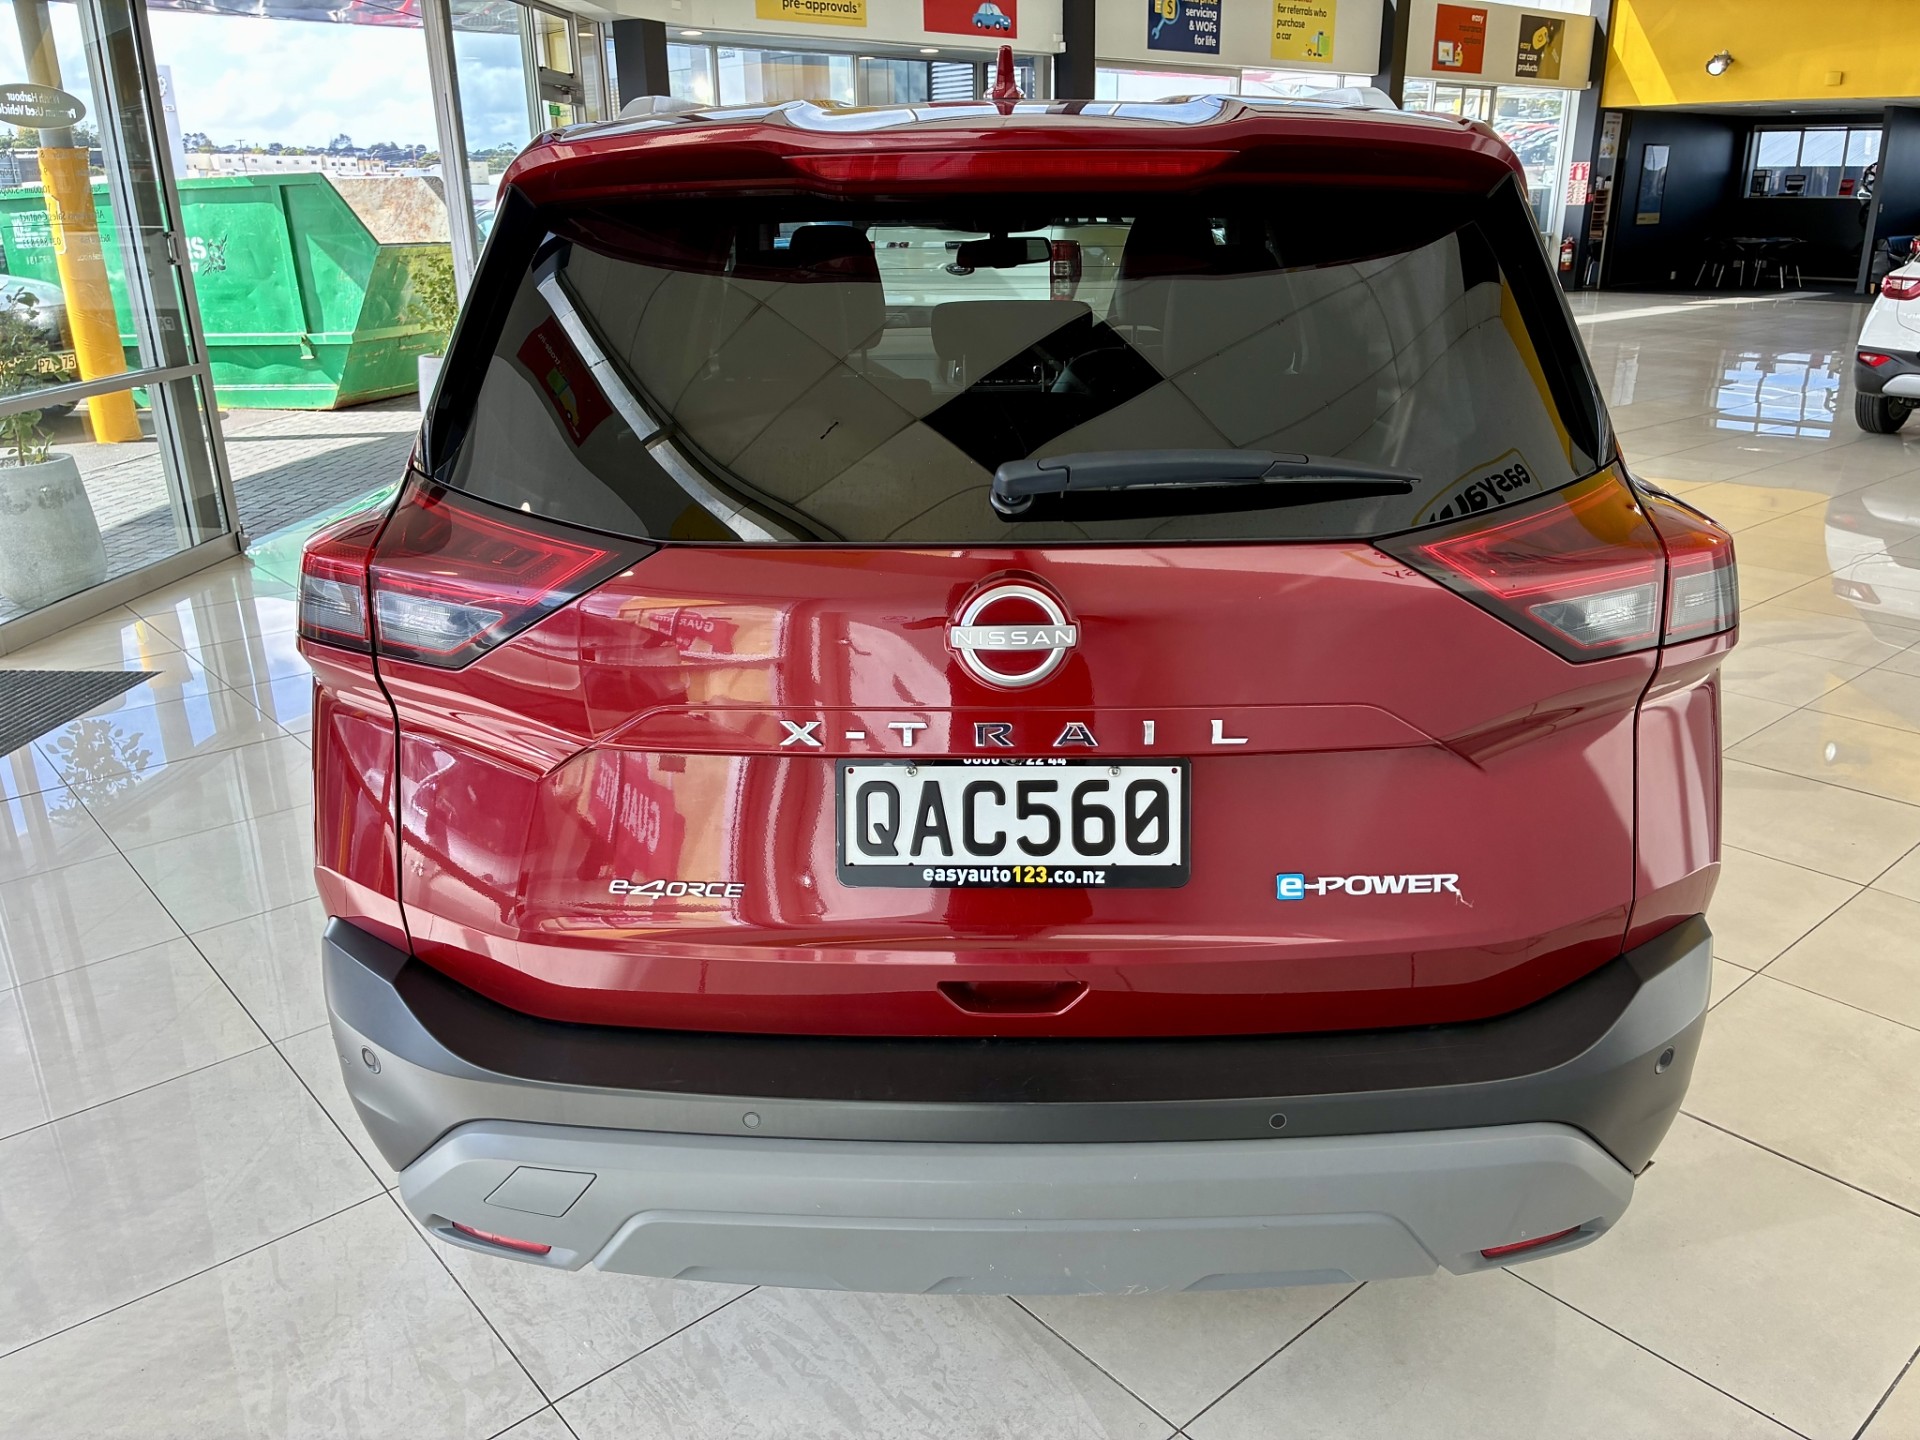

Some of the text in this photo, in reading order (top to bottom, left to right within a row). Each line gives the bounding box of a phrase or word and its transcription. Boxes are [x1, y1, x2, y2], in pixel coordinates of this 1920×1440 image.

[1185, 7, 1217, 21] servicing
[1278, 3, 1327, 17] for referrals who
[1189, 20, 1217, 33] & WOFs
[1277, 18, 1305, 28] purchase
[1194, 34, 1216, 46] for life
[1517, 63, 1538, 72] products
[39, 355, 76, 372] PZ75
[955, 629, 1074, 645] NISSAN
[780, 719, 1249, 748] X-TRAIL
[855, 779, 1169, 857] QAC560
[922, 866, 1106, 886] easyauto123.co.nz
[1276, 872, 1463, 901] e-POWER
